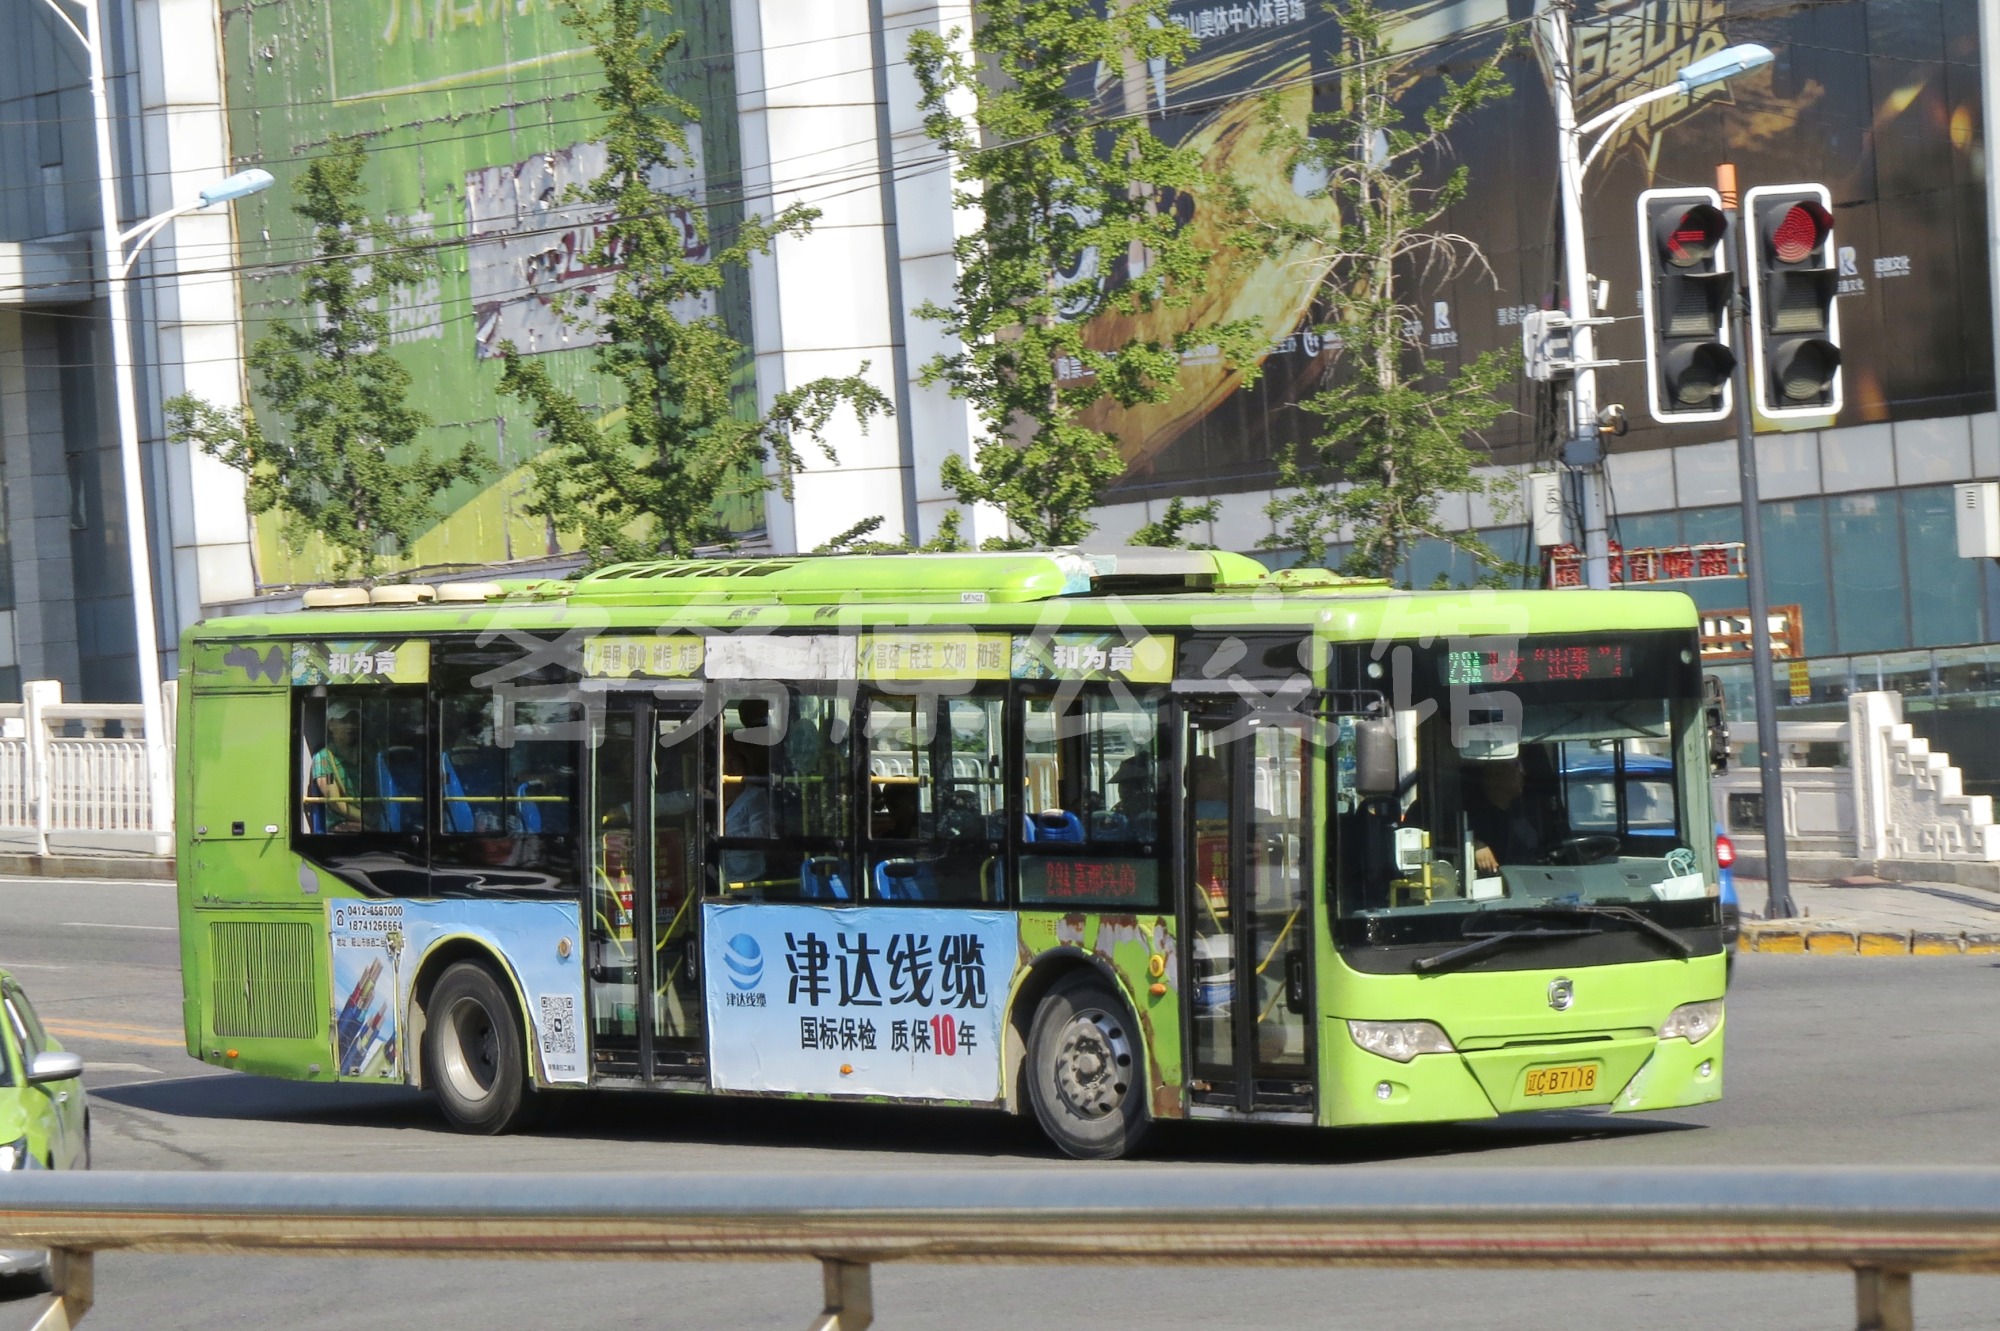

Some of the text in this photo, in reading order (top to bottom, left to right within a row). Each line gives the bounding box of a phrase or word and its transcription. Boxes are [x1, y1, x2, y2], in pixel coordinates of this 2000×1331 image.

[328, 651, 397, 675] 和为贵
[909, 643, 932, 669] 民主
[942, 643, 967, 669] 文明
[1053, 645, 1134, 671] 和为贵
[784, 932, 988, 1009] 津达线缆
[726, 992, 767, 1008] 津达线缆
[800, 1013, 977, 1056] 国标保检 质保10年
